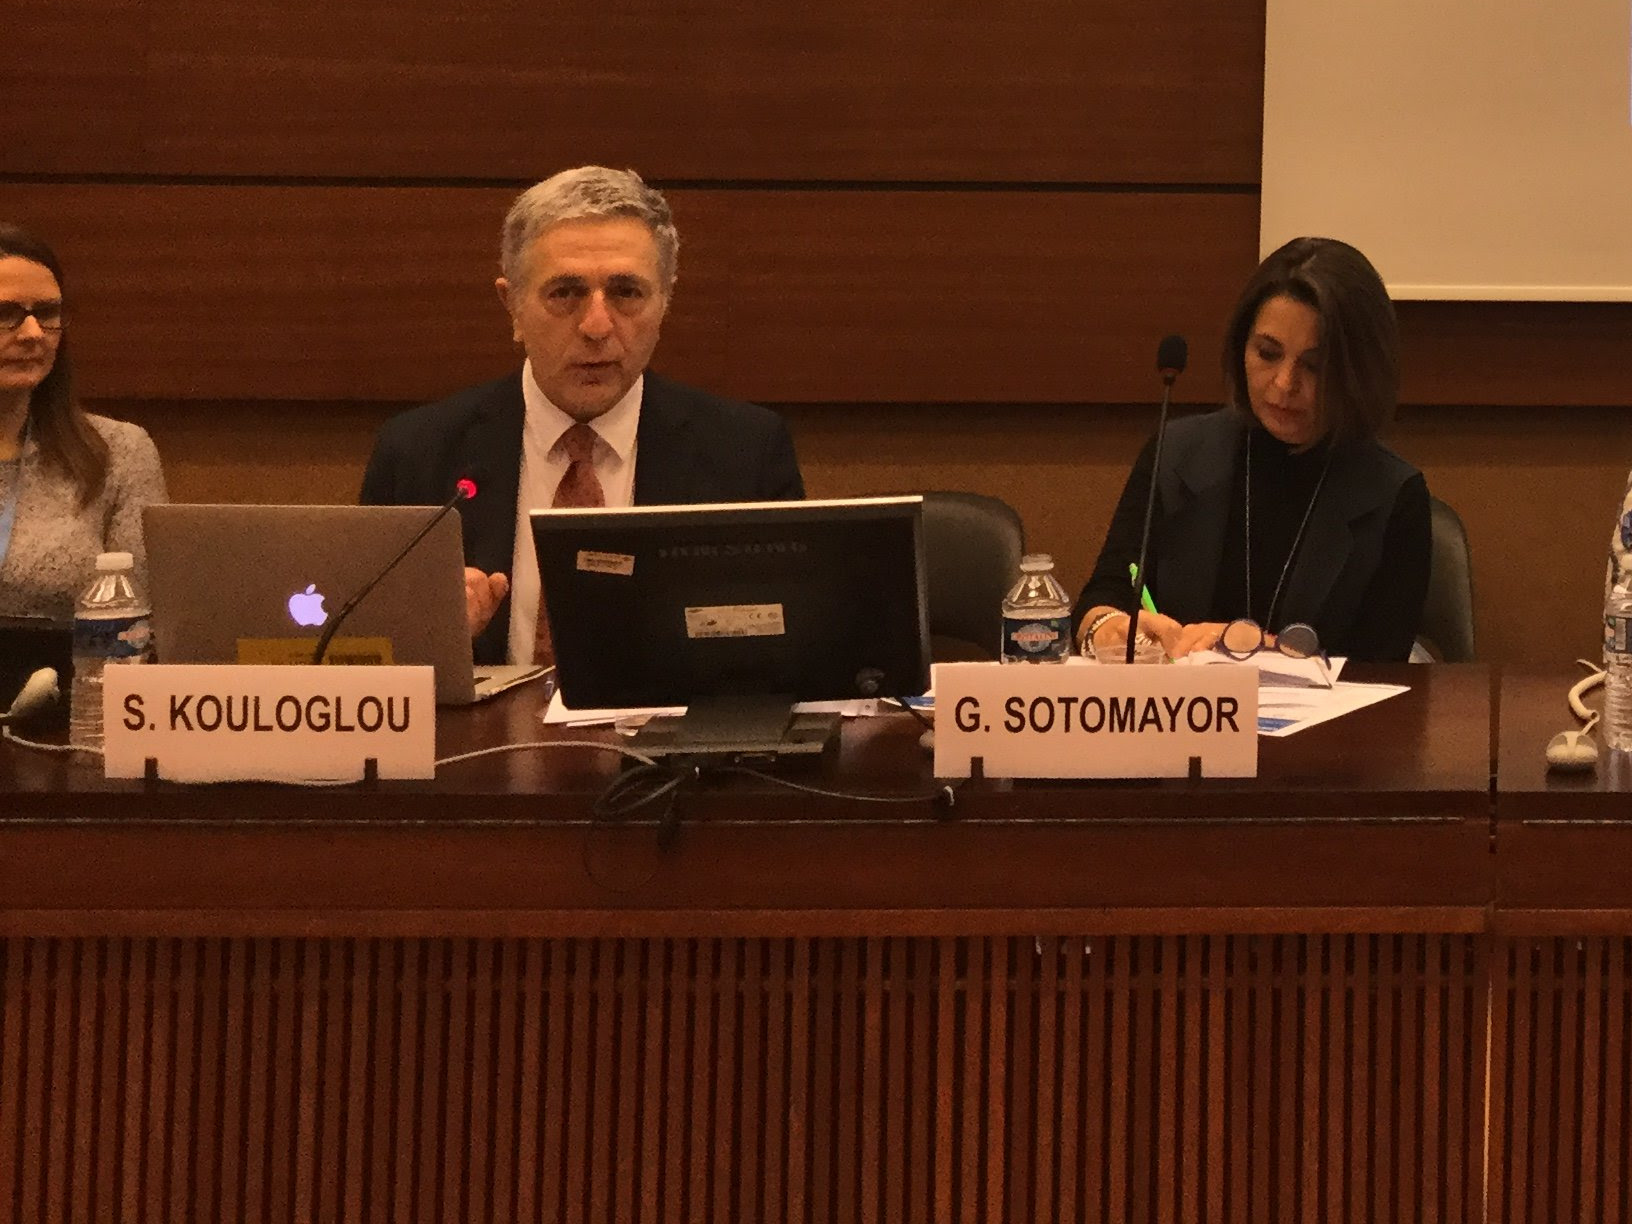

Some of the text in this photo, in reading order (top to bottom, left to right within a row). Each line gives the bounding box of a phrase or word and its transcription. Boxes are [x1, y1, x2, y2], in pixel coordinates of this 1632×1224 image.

[123, 694, 410, 733] S. KOULOGLOU
[955, 697, 1240, 733] G. SOTOMAYOR
